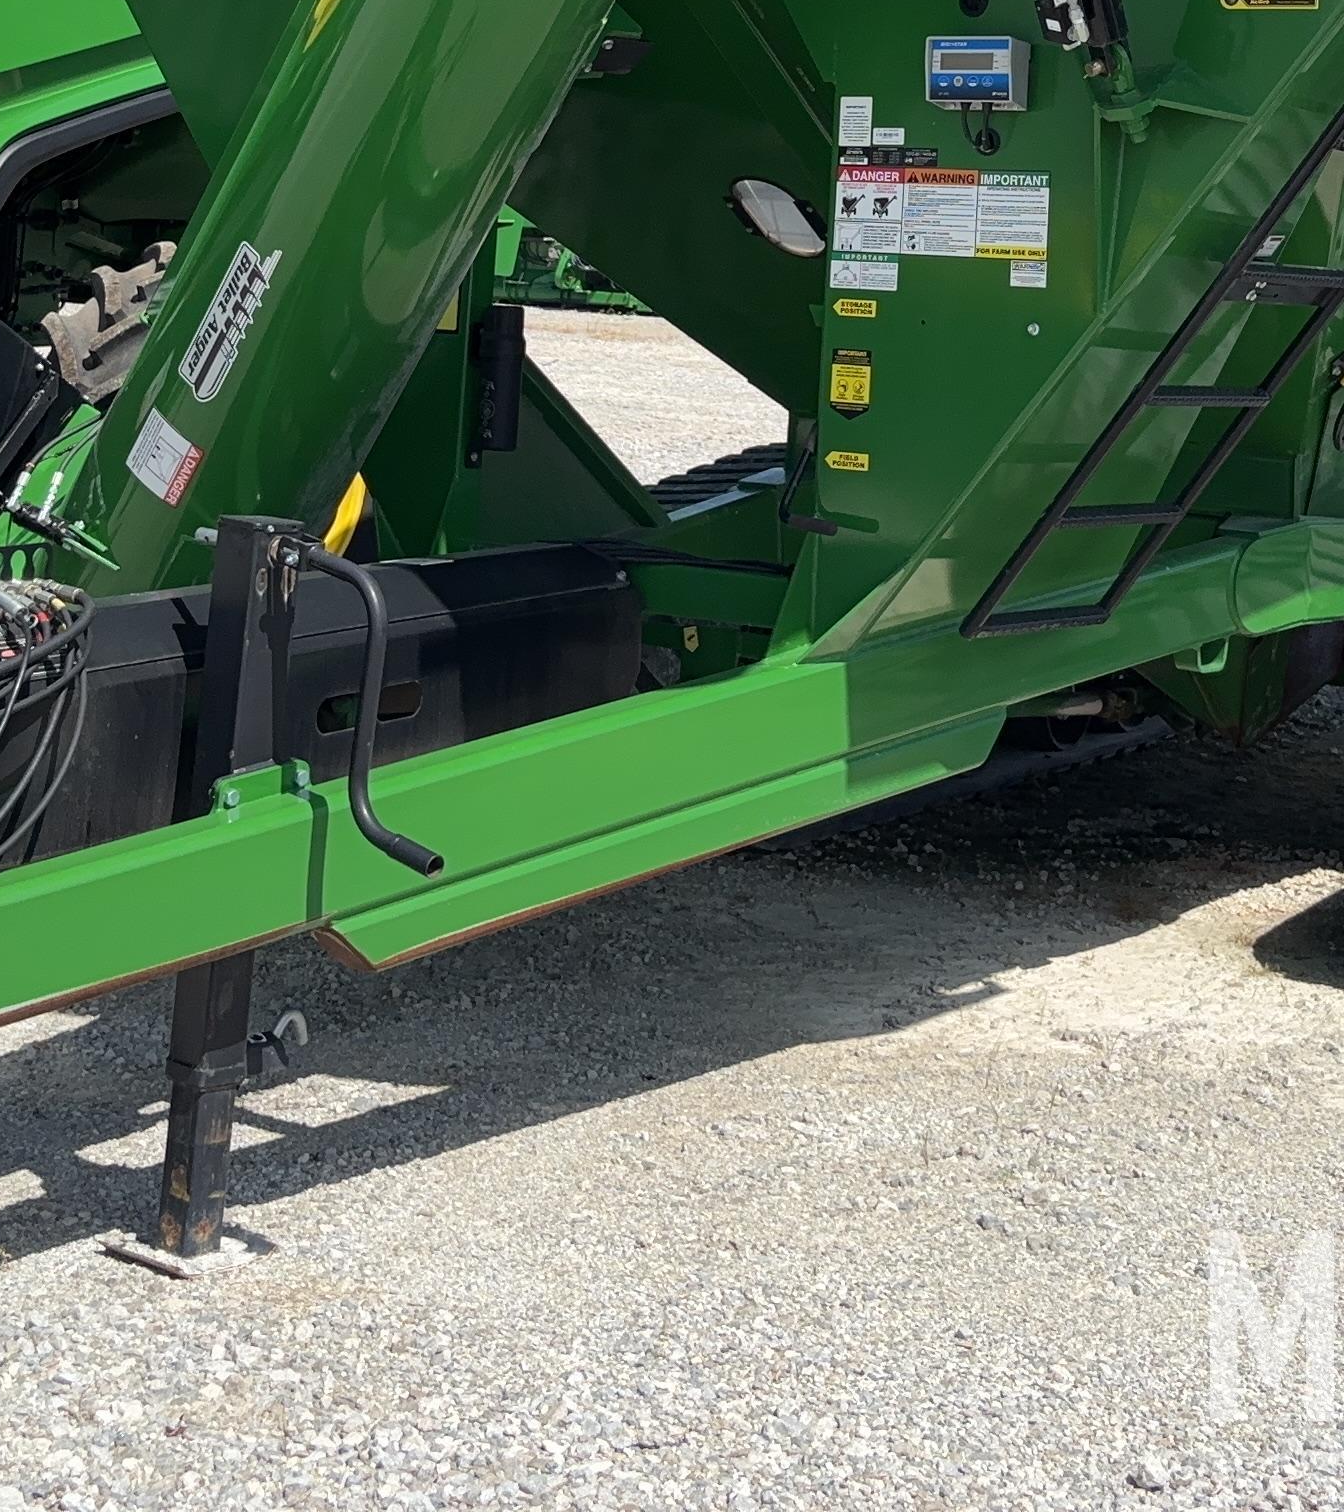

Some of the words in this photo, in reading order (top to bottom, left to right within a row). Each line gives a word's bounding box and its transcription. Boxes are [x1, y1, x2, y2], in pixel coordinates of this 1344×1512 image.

[853, 170, 900, 182] DANGER
[920, 173, 975, 185] WARNING
[980, 174, 1049, 187] IMPORTANT
[841, 254, 889, 262] IMPORTANT
[991, 248, 1010, 256] FARM
[1012, 249, 1025, 257] USE
[1027, 250, 1047, 258] ONLY
[213, 251, 256, 315] Bullet
[840, 301, 873, 309] STORAGE
[179, 311, 224, 378] Auger
[832, 461, 865, 469] POSITION
[163, 456, 198, 506] DANGER
